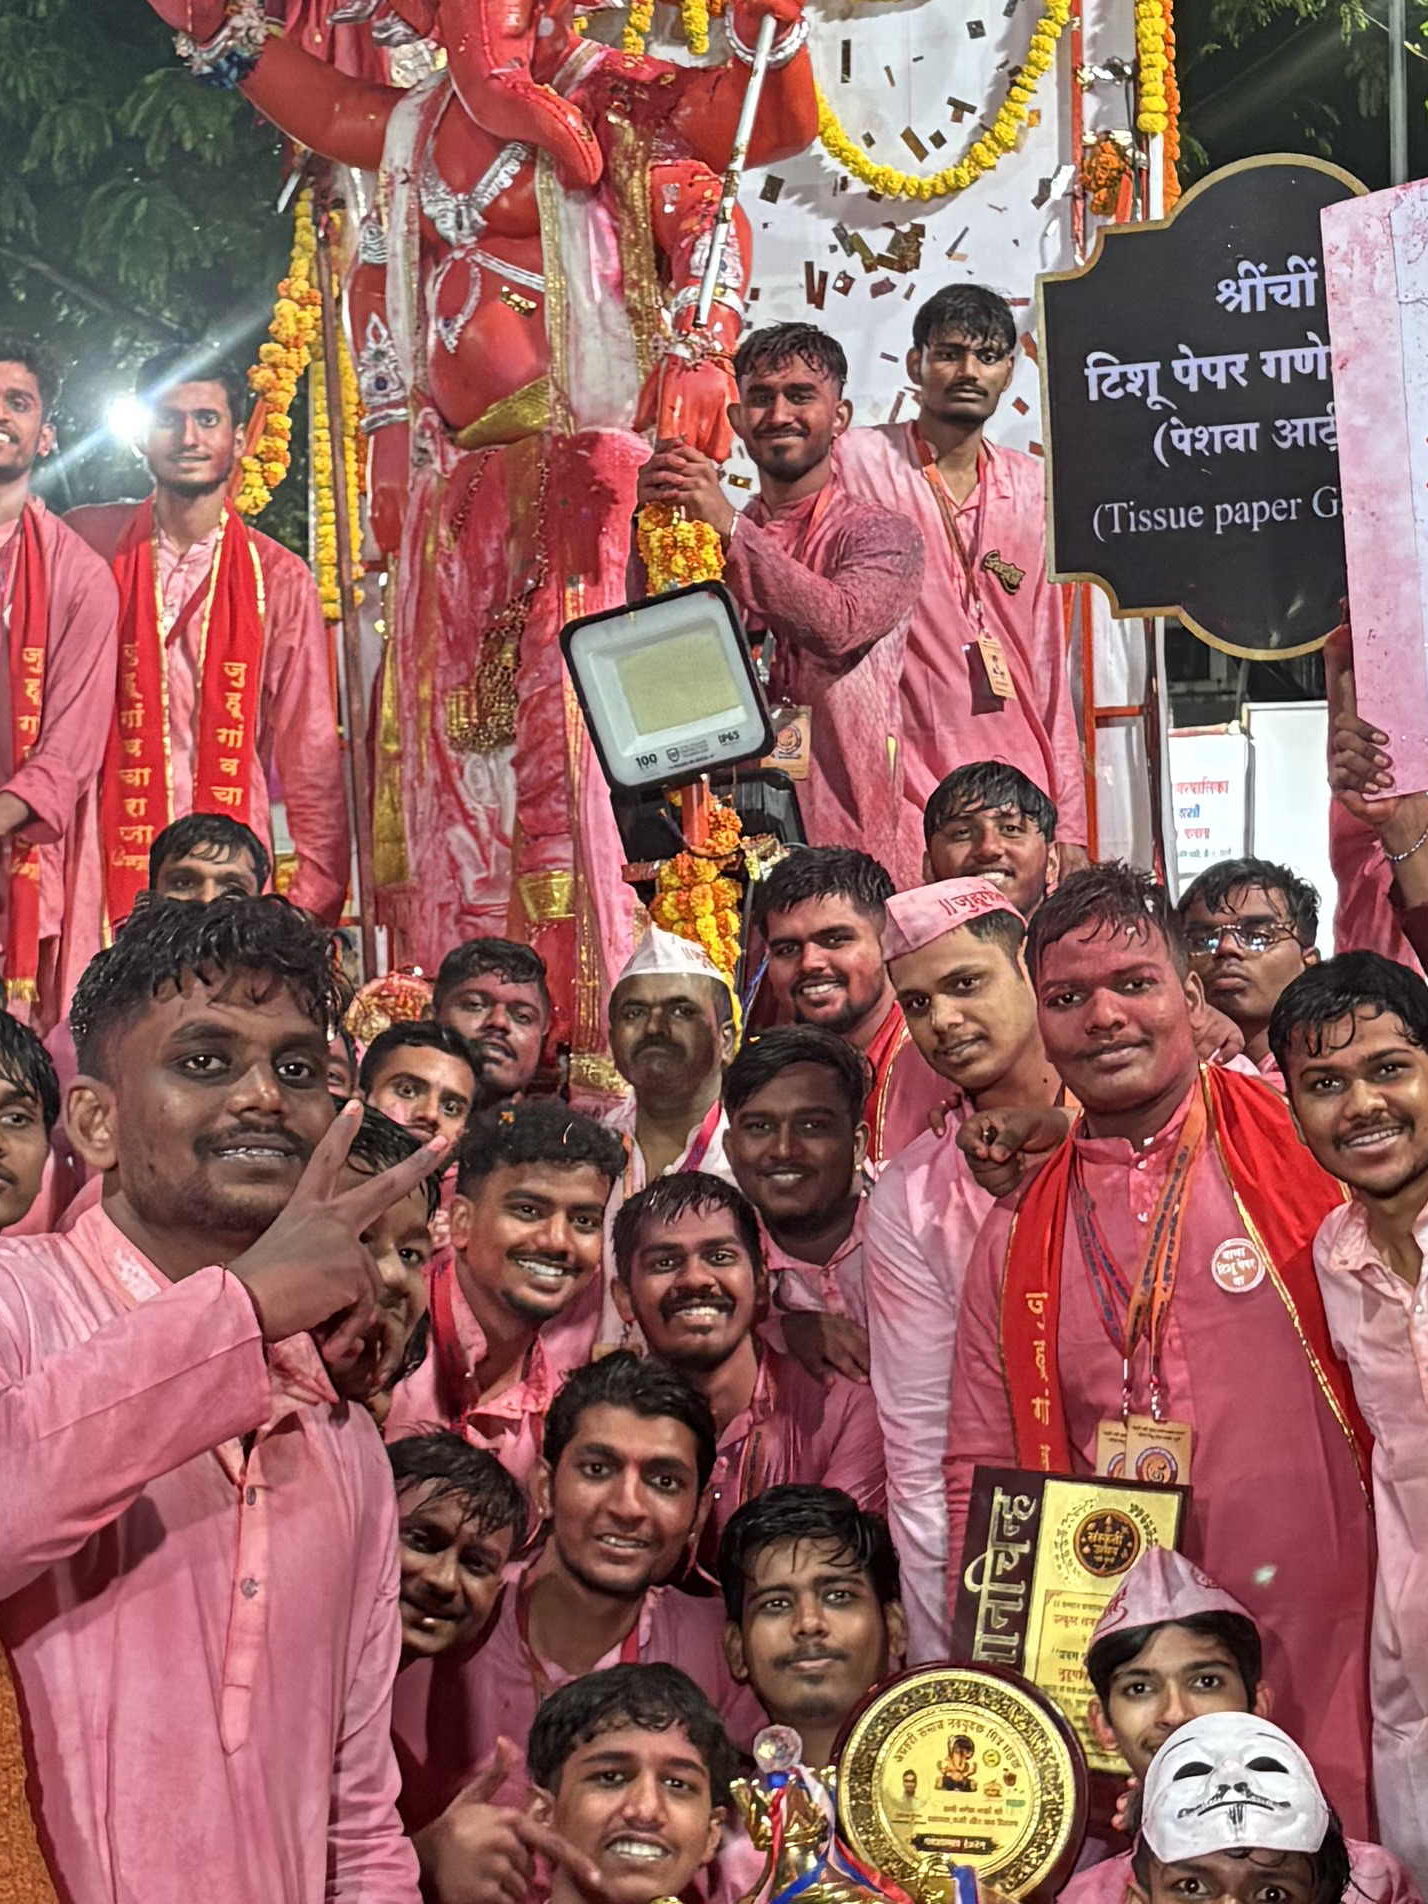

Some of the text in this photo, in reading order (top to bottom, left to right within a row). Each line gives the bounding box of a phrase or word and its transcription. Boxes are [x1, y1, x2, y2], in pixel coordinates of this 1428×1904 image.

[1083, 330, 1332, 411] टिशू पेपर गणे
[1153, 415, 1261, 469] (पेशवा
[1092, 486, 1339, 543] (Tissue paper G
[634, 752, 658, 768] 100
[963, 1485, 1037, 1665] ानचिन्ह
